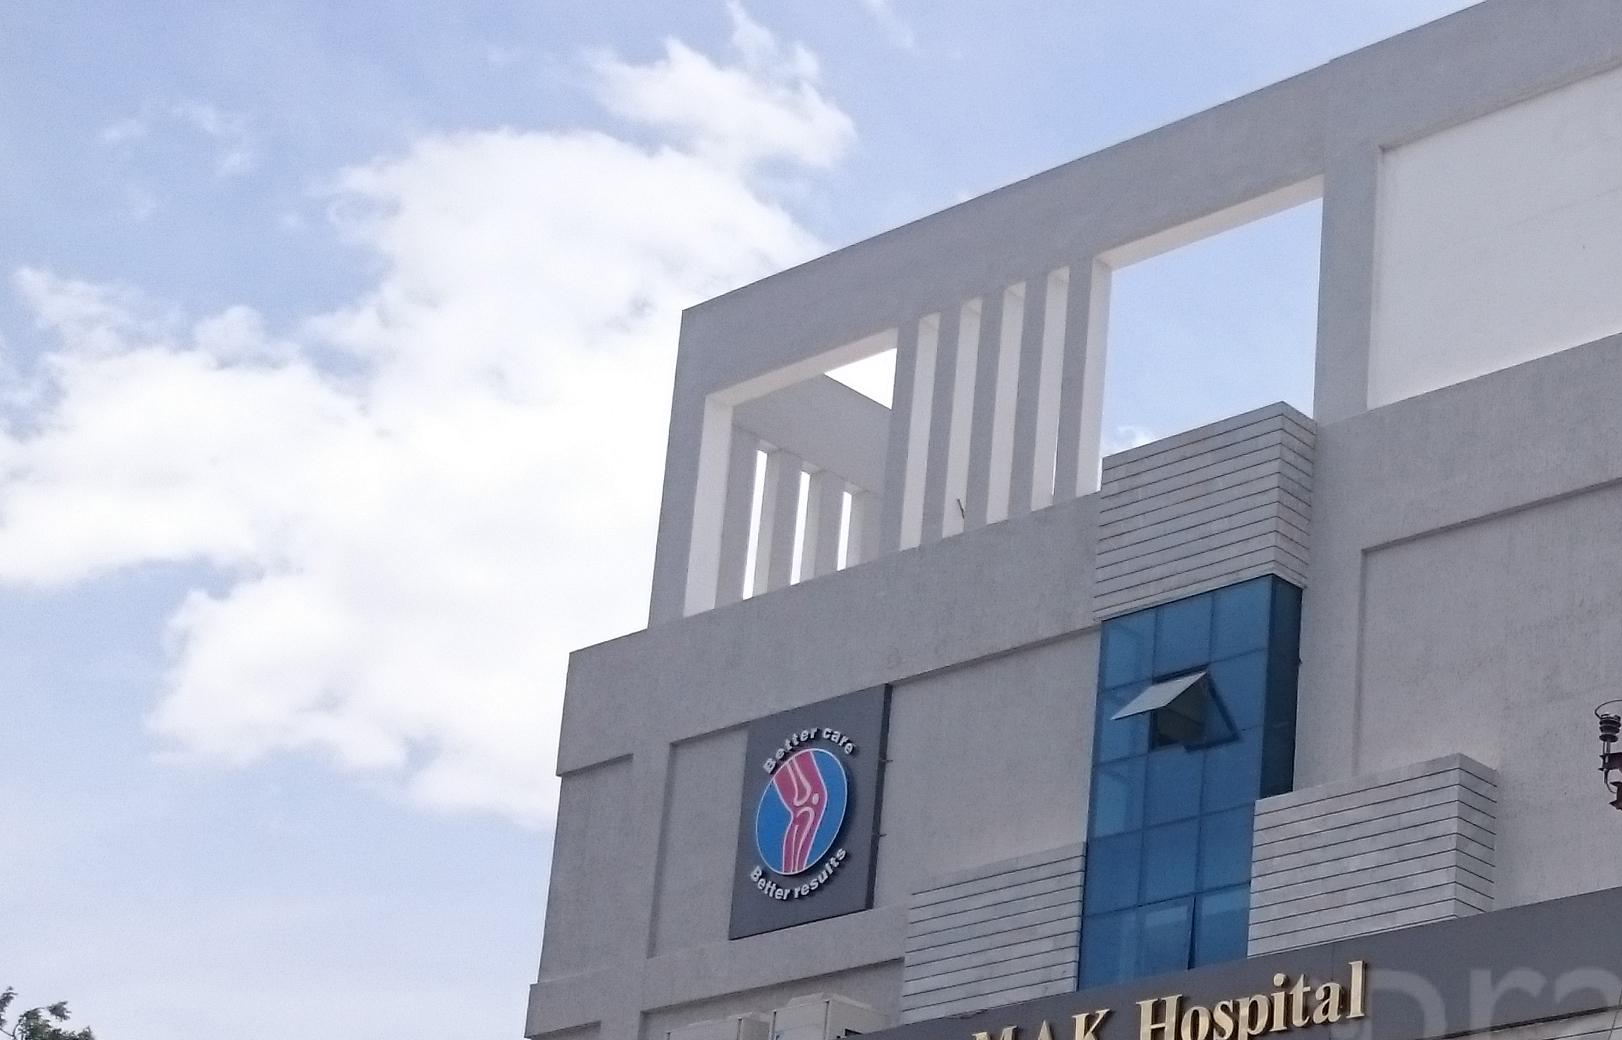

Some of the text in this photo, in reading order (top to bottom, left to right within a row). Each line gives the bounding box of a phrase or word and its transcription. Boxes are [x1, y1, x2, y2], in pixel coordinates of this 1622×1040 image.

[763, 727, 855, 774] Better care
[750, 848, 848, 900] Better results
